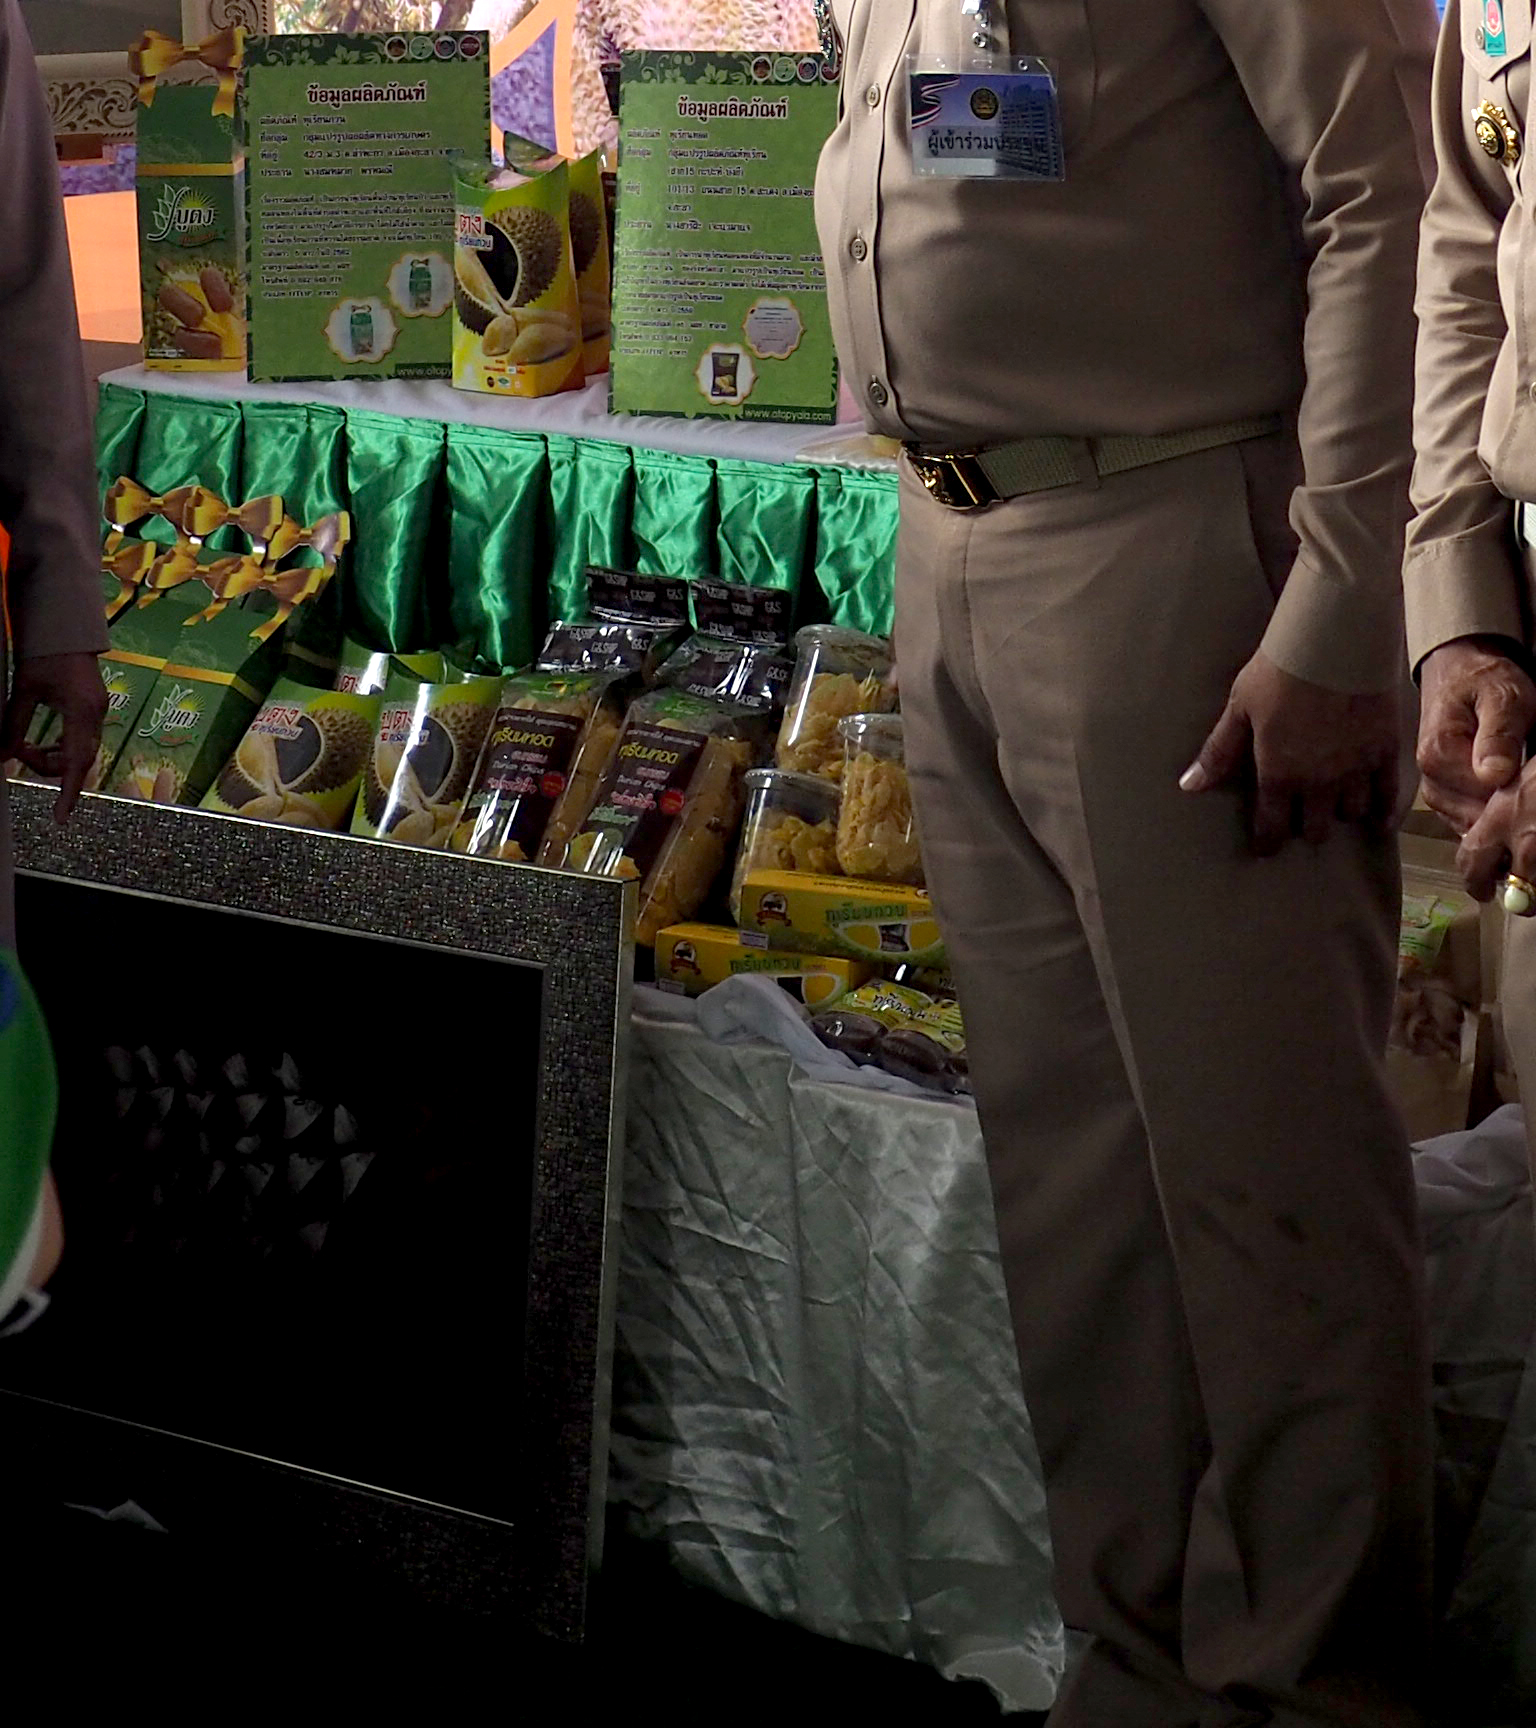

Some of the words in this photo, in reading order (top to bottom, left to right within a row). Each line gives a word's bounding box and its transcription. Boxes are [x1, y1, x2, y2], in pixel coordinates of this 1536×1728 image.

[307, 80, 427, 110] ข้อมูลผลิตภัณฑ์
[677, 95, 789, 123] ข้อมูลผลิตภัณฑ์
